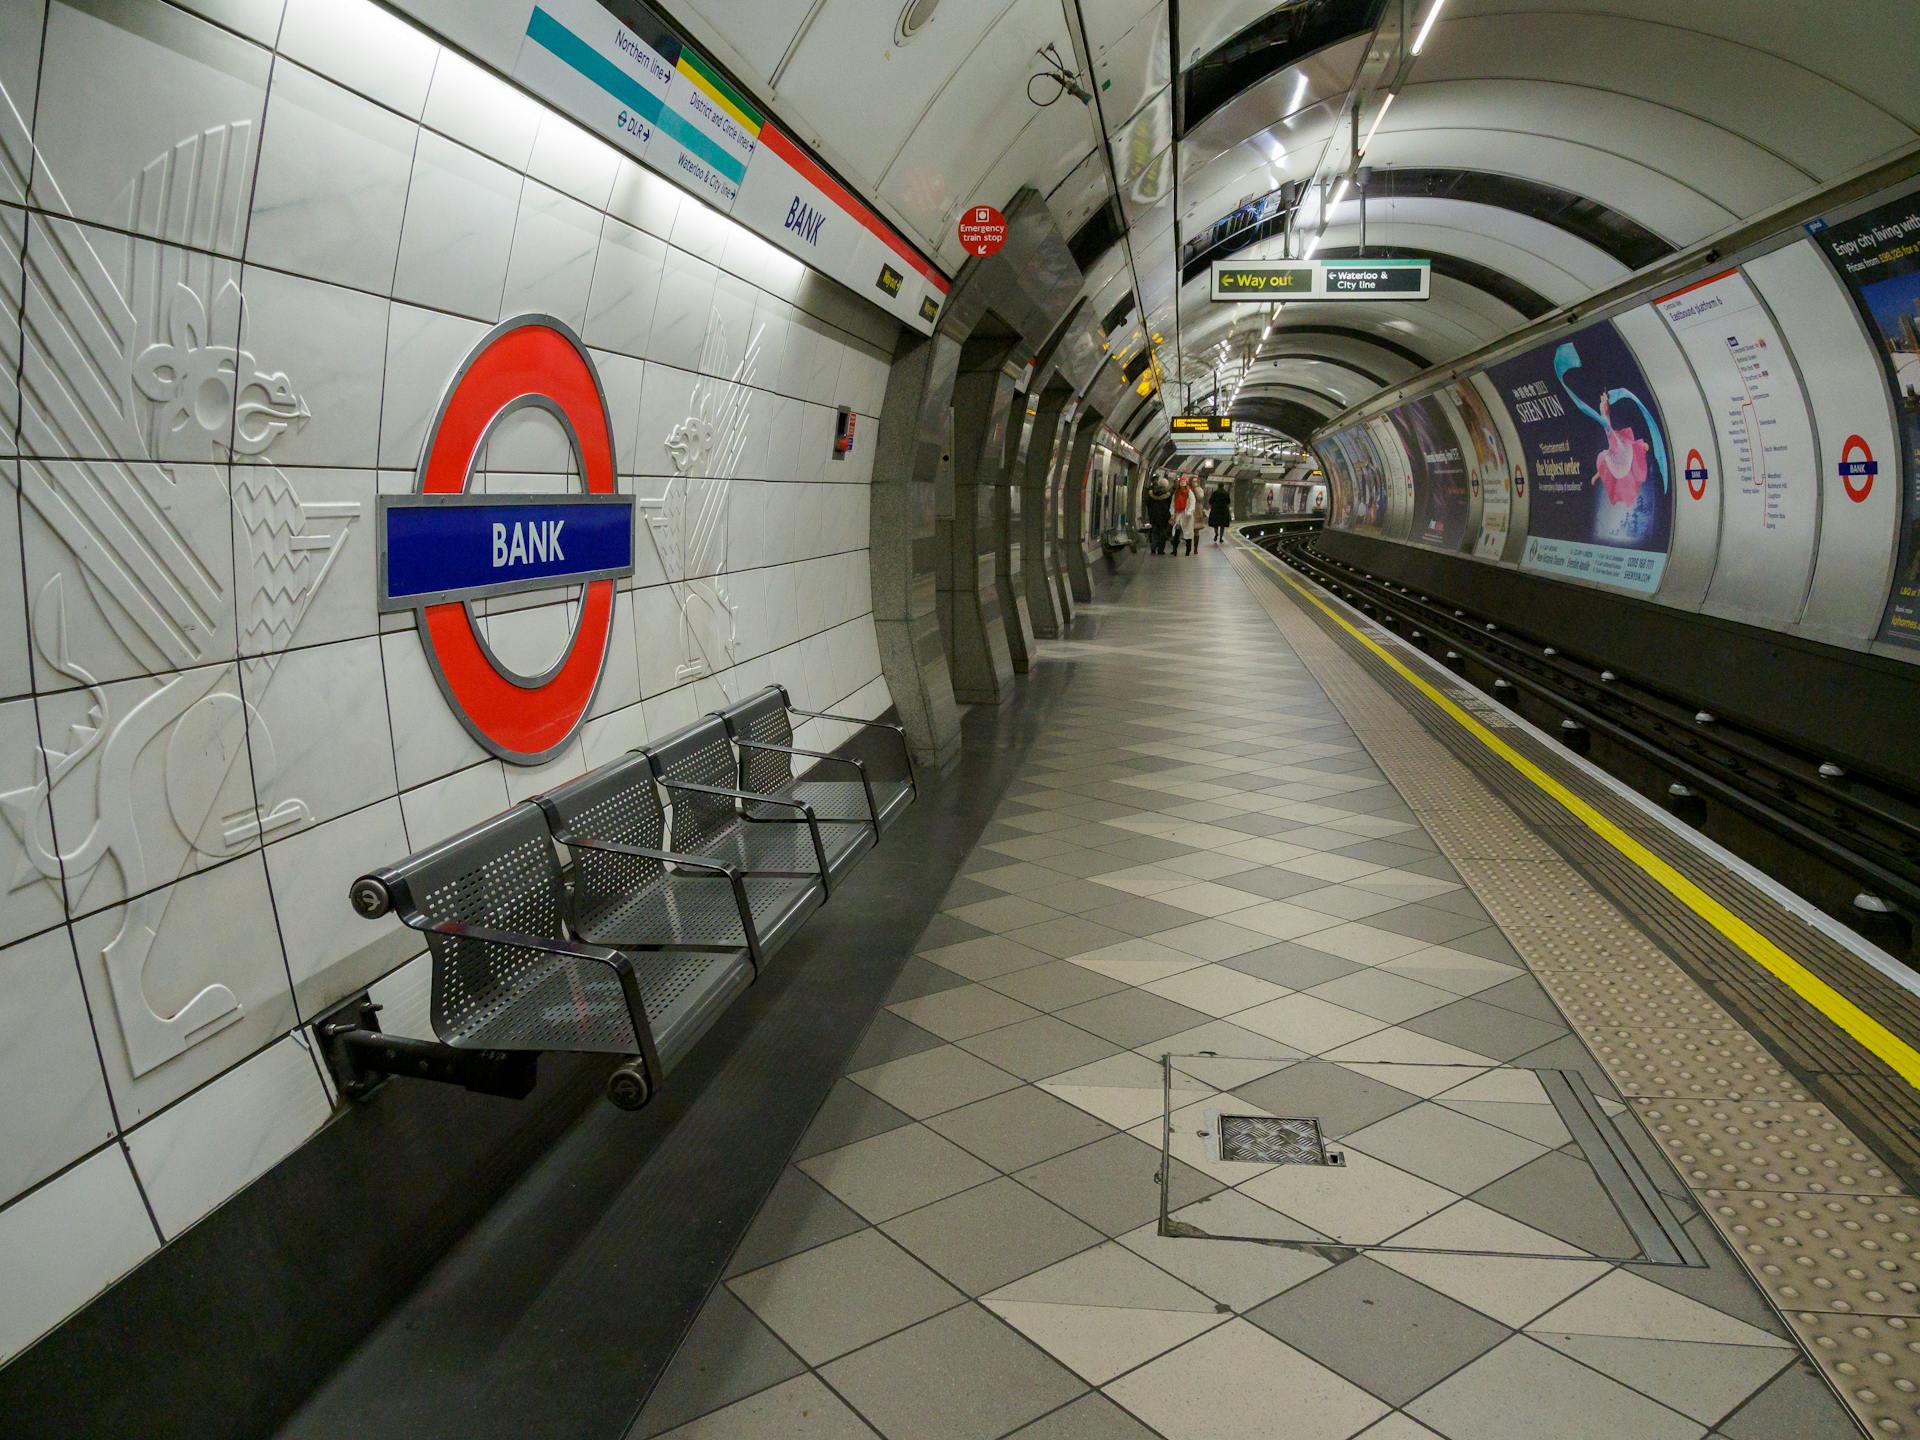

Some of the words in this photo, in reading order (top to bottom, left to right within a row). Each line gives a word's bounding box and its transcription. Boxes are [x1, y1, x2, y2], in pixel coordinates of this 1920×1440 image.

[614, 29, 651, 69] Northern
[650, 57, 664, 80] line
[627, 117, 644, 140] DLR
[689, 91, 712, 120] District
[711, 110, 725, 128] and
[722, 118, 738, 140] Circle
[737, 132, 750, 150] lines
[677, 151, 704, 180] Waterloo
[703, 170, 711, 183] &
[709, 174, 722, 194] City
[720, 184, 732, 199] line
[784, 195, 826, 247] BANK
[960, 224, 1005, 234] Emergency
[963, 234, 982, 242] train
[983, 234, 1003, 243] stop
[1832, 240, 1860, 256] Enjoy
[1857, 233, 1877, 248] city
[1871, 224, 1904, 240] living
[1845, 262, 1866, 273] Prices
[1863, 256, 1881, 268] from
[1901, 244, 1914, 256] for
[1236, 274, 1266, 289] Way
[1270, 276, 1294, 286] out
[1337, 280, 1358, 291] City
[1358, 280, 1376, 289] line
[1338, 271, 1378, 280] Waterloo
[1380, 271, 1389, 280] &
[1694, 298, 1717, 315] platform
[1515, 399, 1545, 424] SHEN
[1541, 394, 1566, 420] YUN
[1535, 458, 1546, 477] the
[1543, 458, 1565, 481] highest
[1563, 456, 1581, 476] order
[1849, 463, 1867, 473] BANK
[492, 519, 565, 568] BANK
